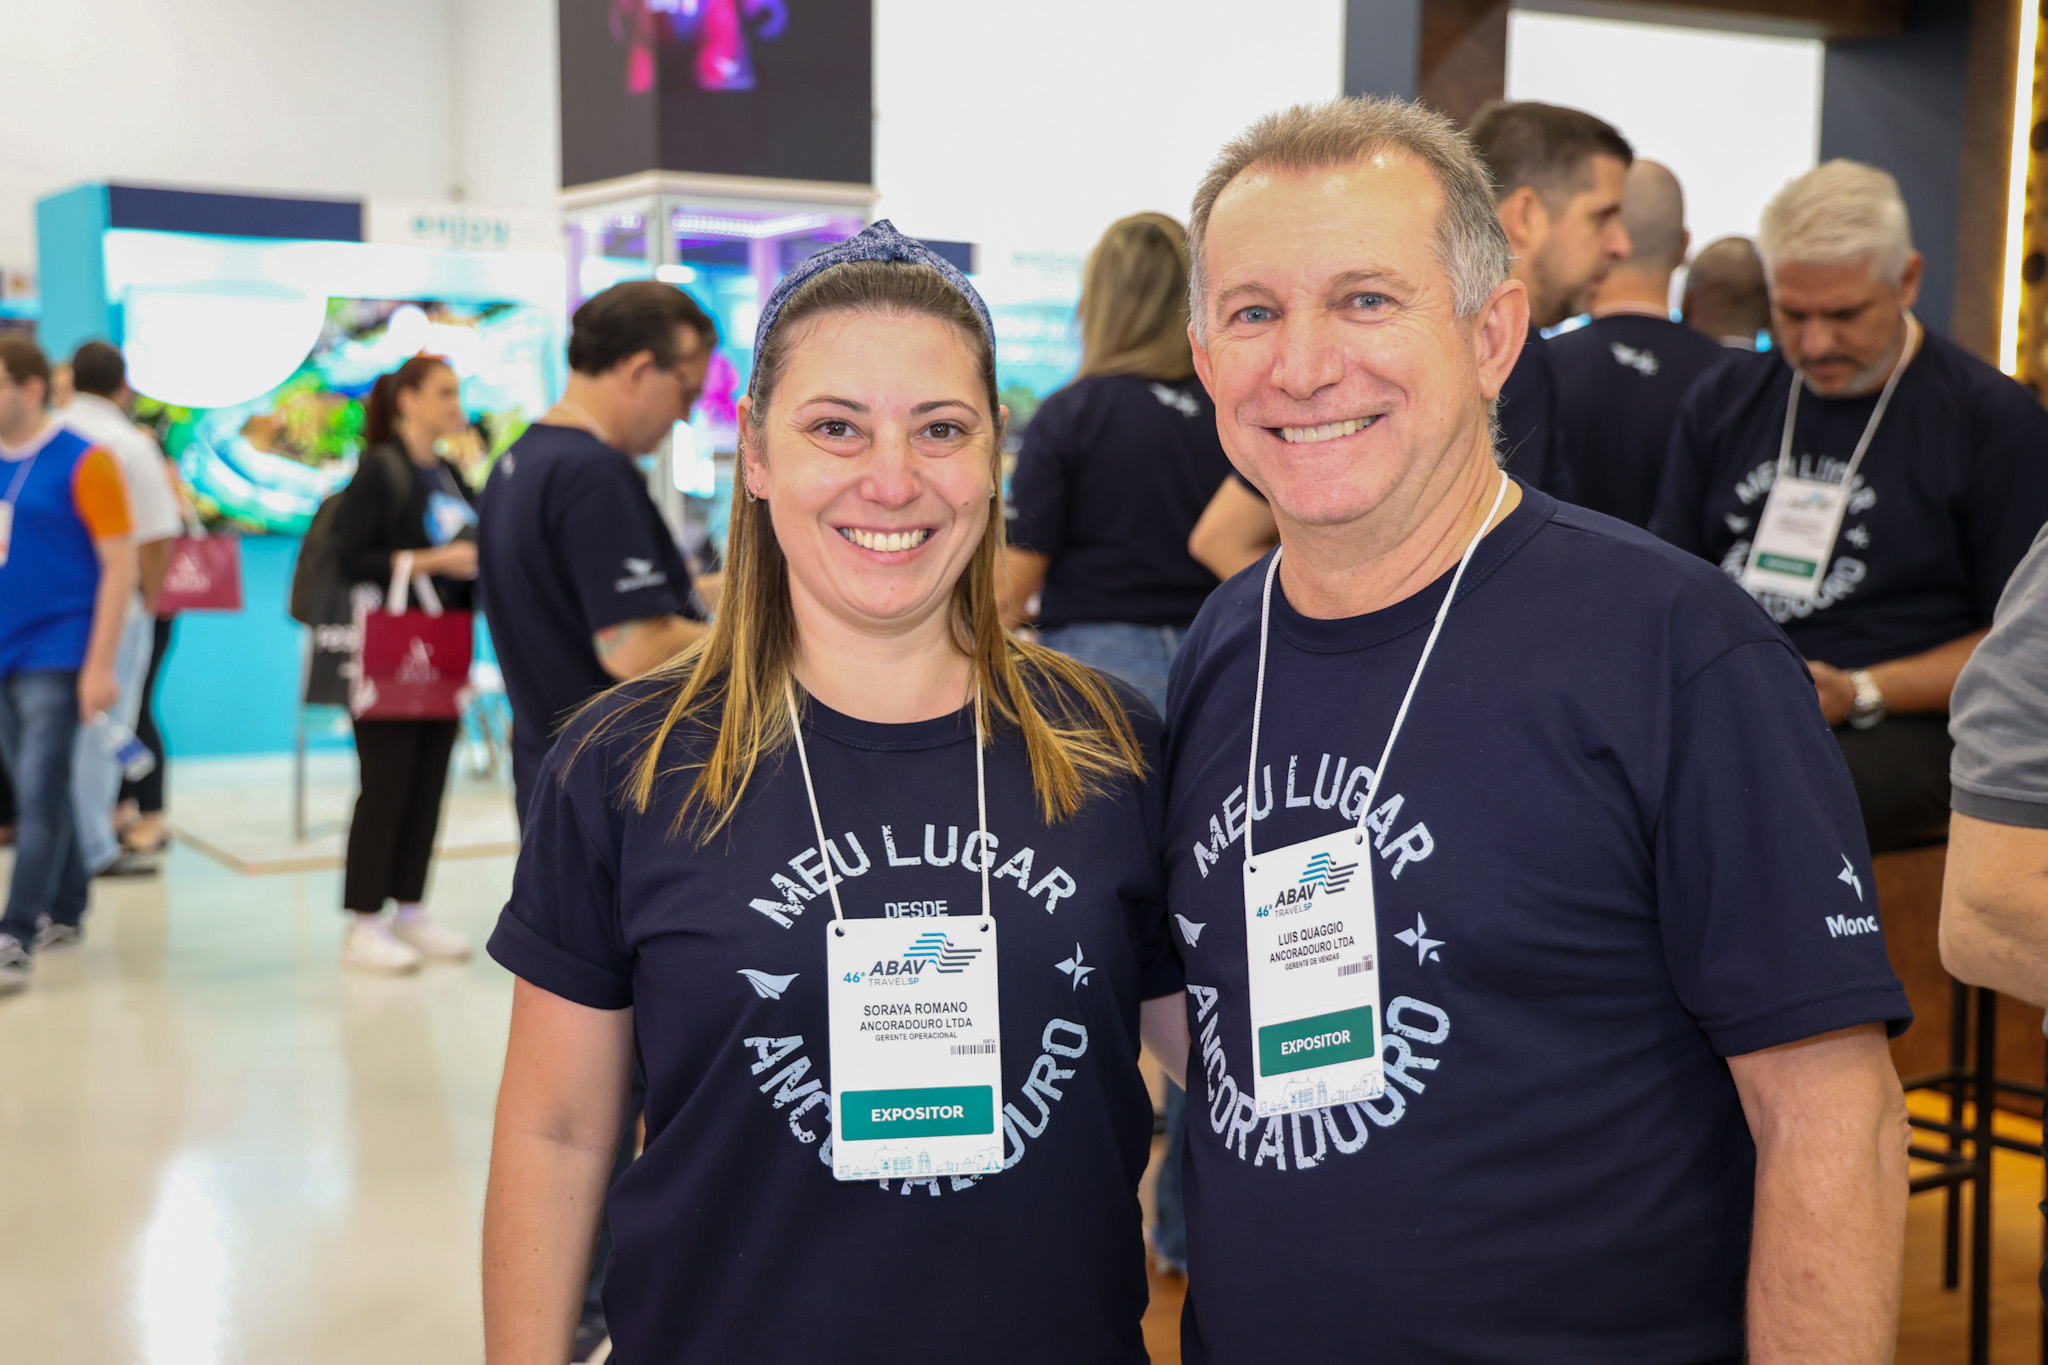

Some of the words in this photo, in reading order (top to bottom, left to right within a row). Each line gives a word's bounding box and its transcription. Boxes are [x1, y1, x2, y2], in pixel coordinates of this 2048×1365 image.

[1193, 764, 1274, 879] MEU
[1285, 752, 1435, 881] LUGAR
[748, 831, 872, 930] MEU
[881, 823, 1077, 915] LUGAR
[1275, 882, 1317, 908] ABAV
[884, 900, 949, 919] DESDE
[1278, 931, 1299, 946] LUIS
[1300, 921, 1344, 941] QUAGGIO
[1269, 940, 1332, 963] ANCORADOURO
[1333, 936, 1355, 949] LTDA
[869, 959, 927, 976] ABAV
[1285, 959, 1309, 970] GERENTE
[1310, 957, 1317, 965] DE
[1317, 953, 1340, 963] VENDAS
[863, 1004, 912, 1016] SORAYA
[915, 1002, 968, 1014] ROMANO
[860, 1019, 943, 1031] ANCORADOURO
[946, 1018, 973, 1028] LTDA
[875, 1033, 908, 1041] GERENTE
[909, 1032, 958, 1040] OPERACIONAL
[1281, 1029, 1351, 1055] EXPOSITOR
[1186, 982, 1451, 1171] ANCORADOURO
[871, 1104, 964, 1122] EXPOSITOR
